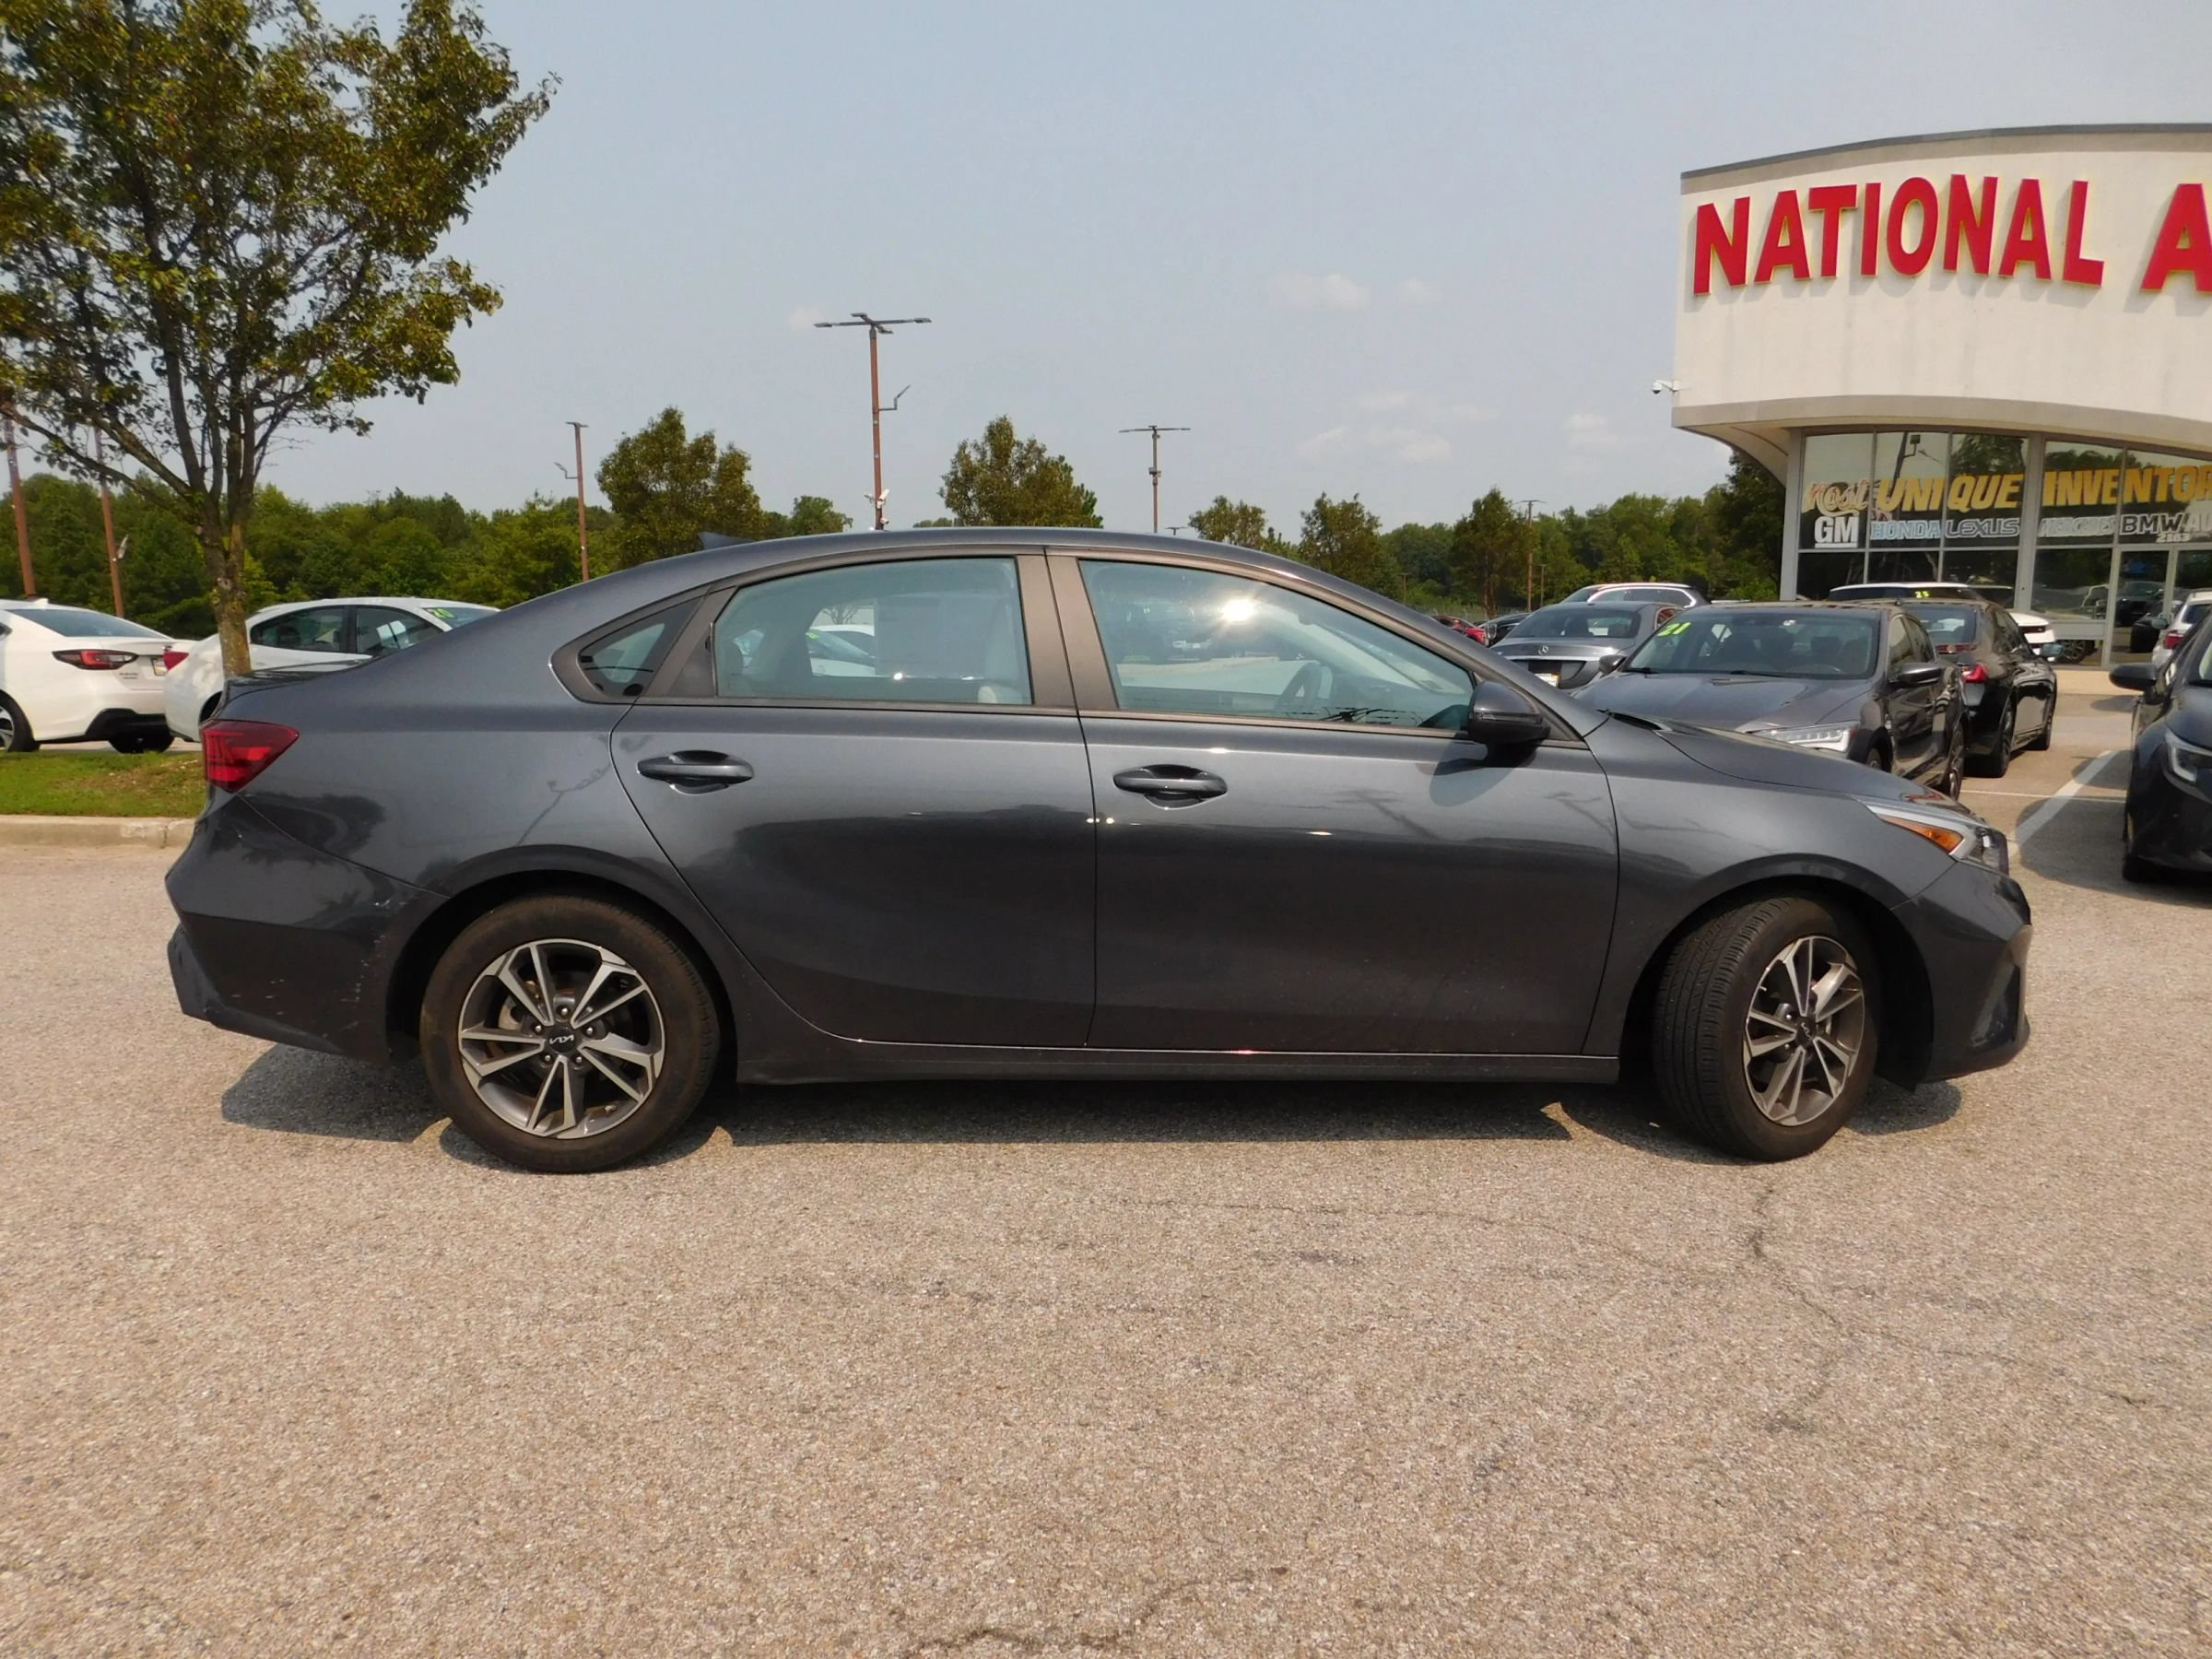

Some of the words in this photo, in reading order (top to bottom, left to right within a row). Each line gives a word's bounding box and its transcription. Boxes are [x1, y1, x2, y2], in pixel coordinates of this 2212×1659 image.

[1693, 173, 2105, 296] NATIONAL
[1875, 472, 2024, 513] UNIQUE
[1814, 515, 1859, 548] GM
[1870, 520, 1942, 540] HONDA
[1945, 517, 2020, 538] LEXUS
[2120, 512, 2183, 535] BMW
[1657, 621, 1692, 636] 21
